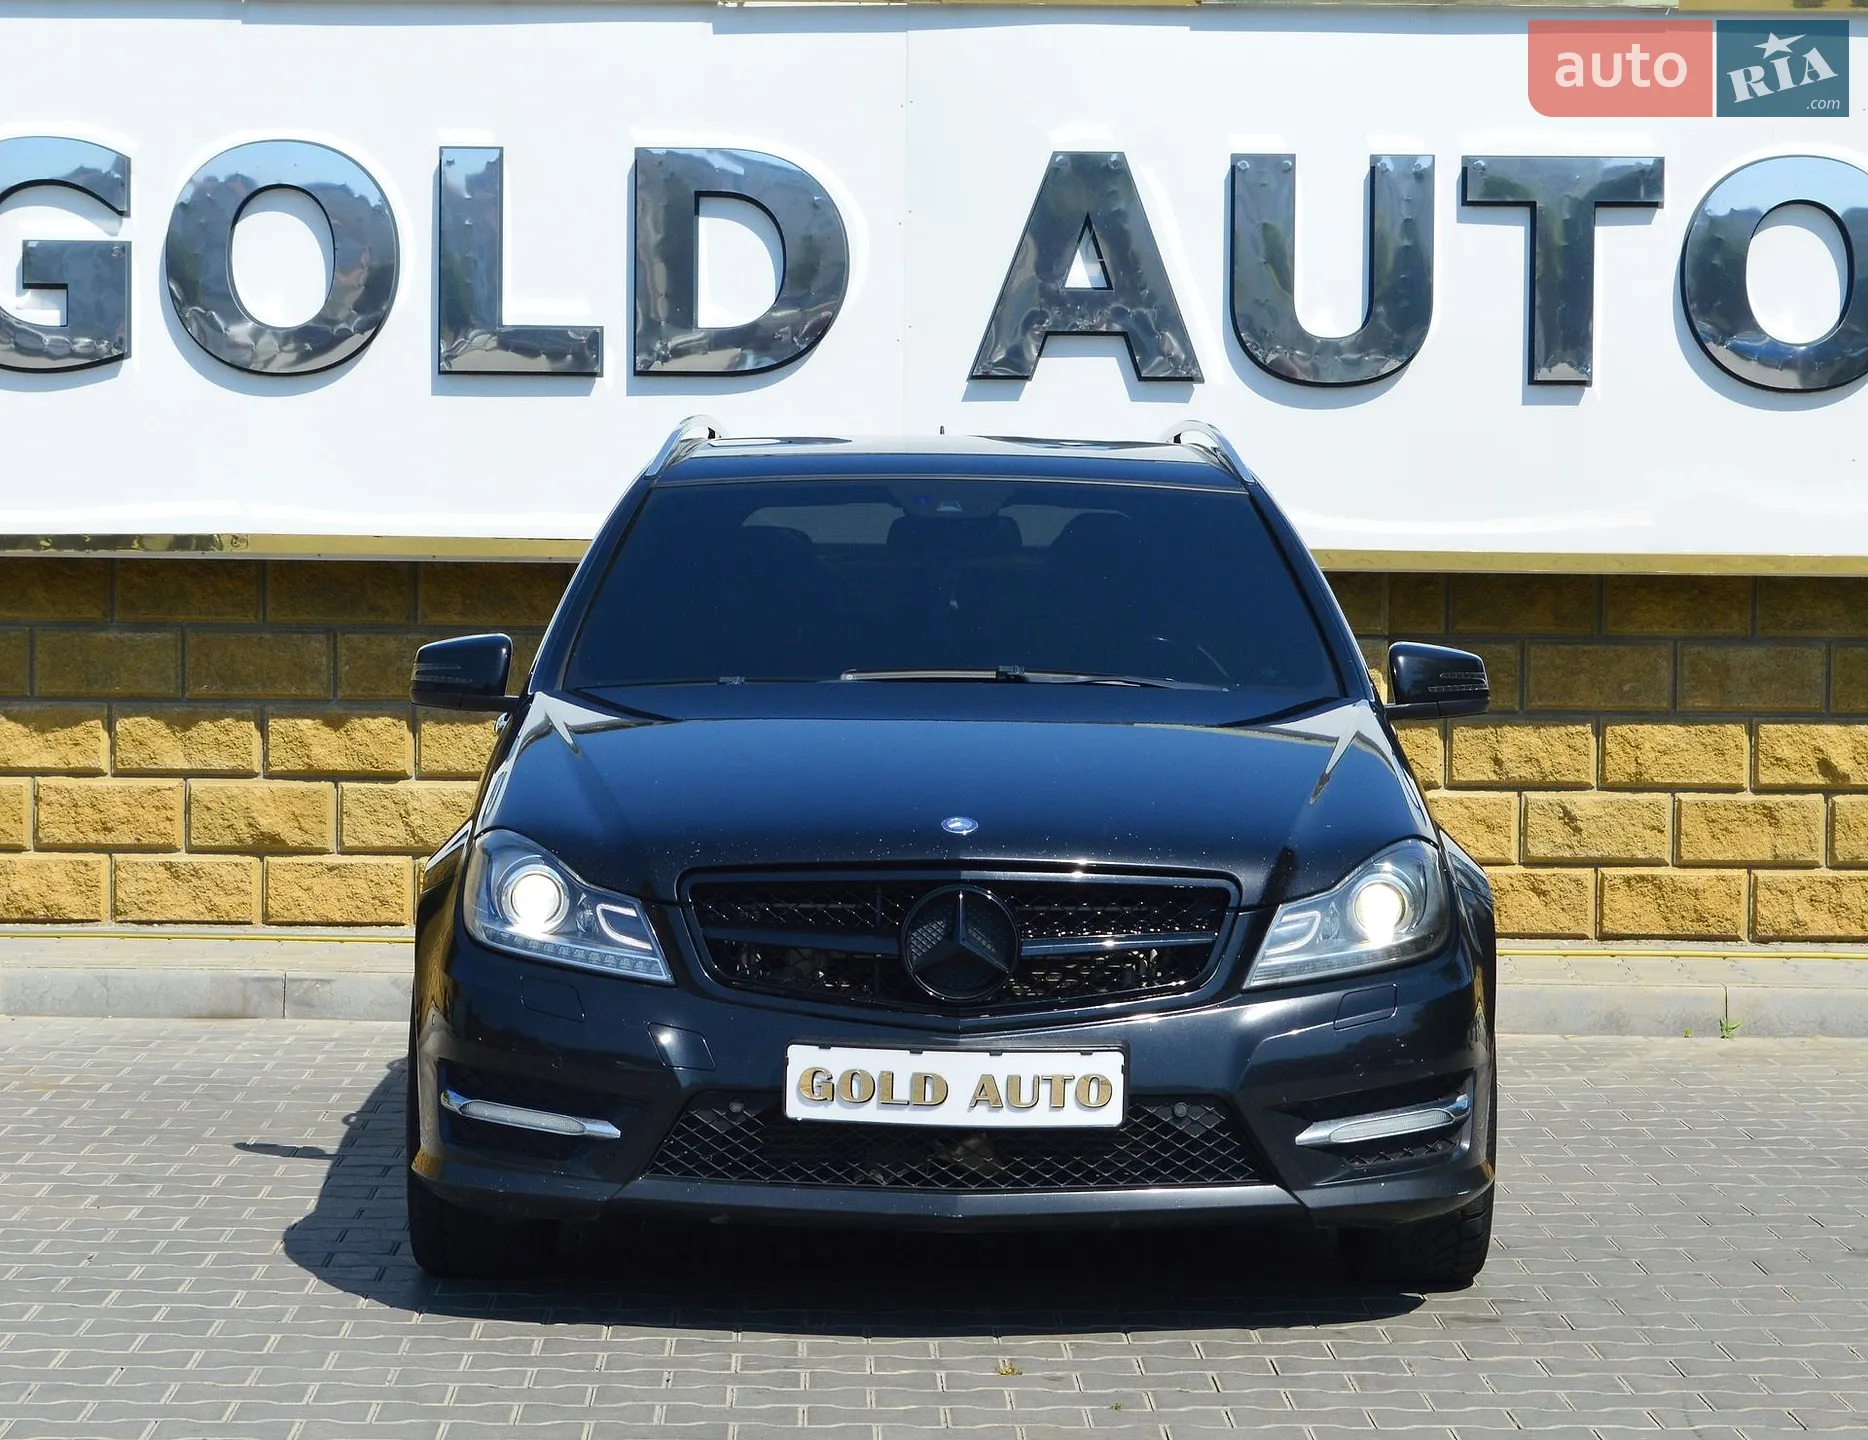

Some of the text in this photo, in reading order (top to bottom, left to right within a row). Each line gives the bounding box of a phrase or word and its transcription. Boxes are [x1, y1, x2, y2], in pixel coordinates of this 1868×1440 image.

[0, 136, 1868, 393] GOLD AUTO
[796, 1066, 1113, 1109] GOLD AUTO
